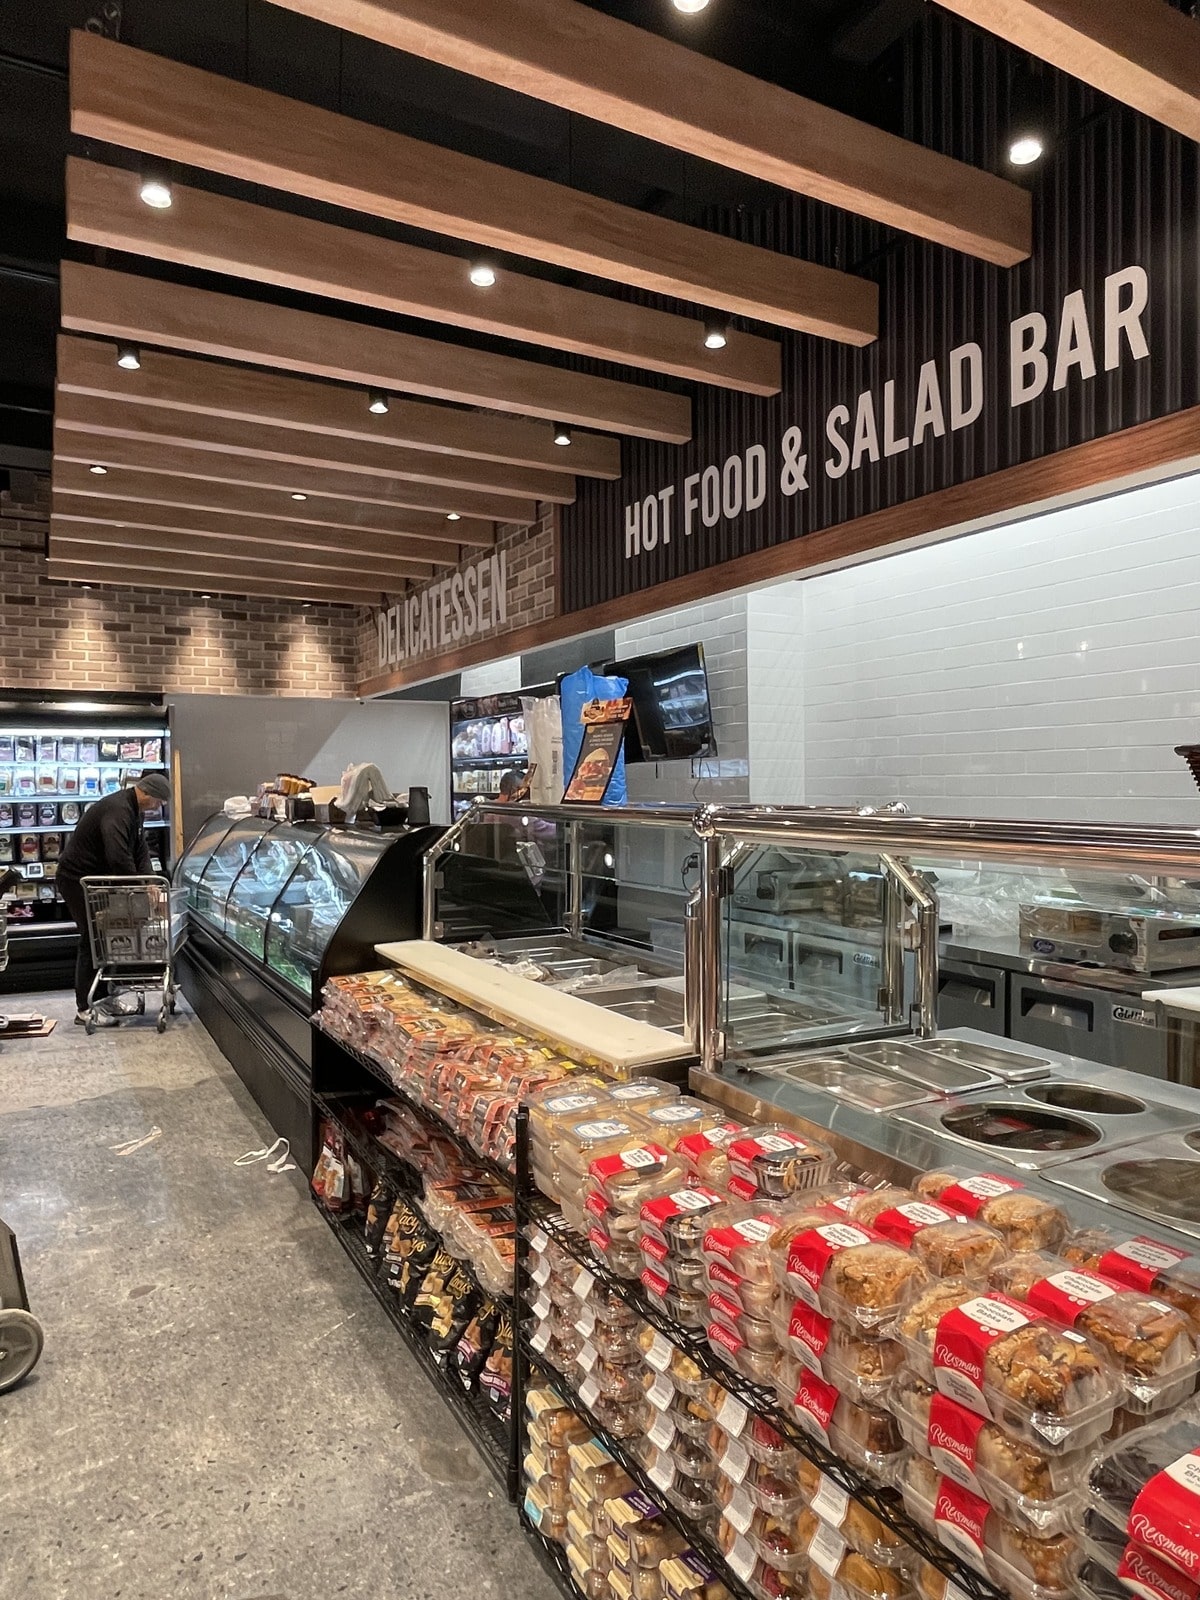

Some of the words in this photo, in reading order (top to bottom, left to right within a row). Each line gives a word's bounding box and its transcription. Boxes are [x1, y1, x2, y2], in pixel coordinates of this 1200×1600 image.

[625, 485, 675, 559] HOT
[684, 444, 767, 536] FOOD
[780, 425, 810, 496] &
[825, 342, 984, 479] SALAD
[1010, 265, 1150, 407] BAR
[378, 549, 507, 668] DELICATESSEN
